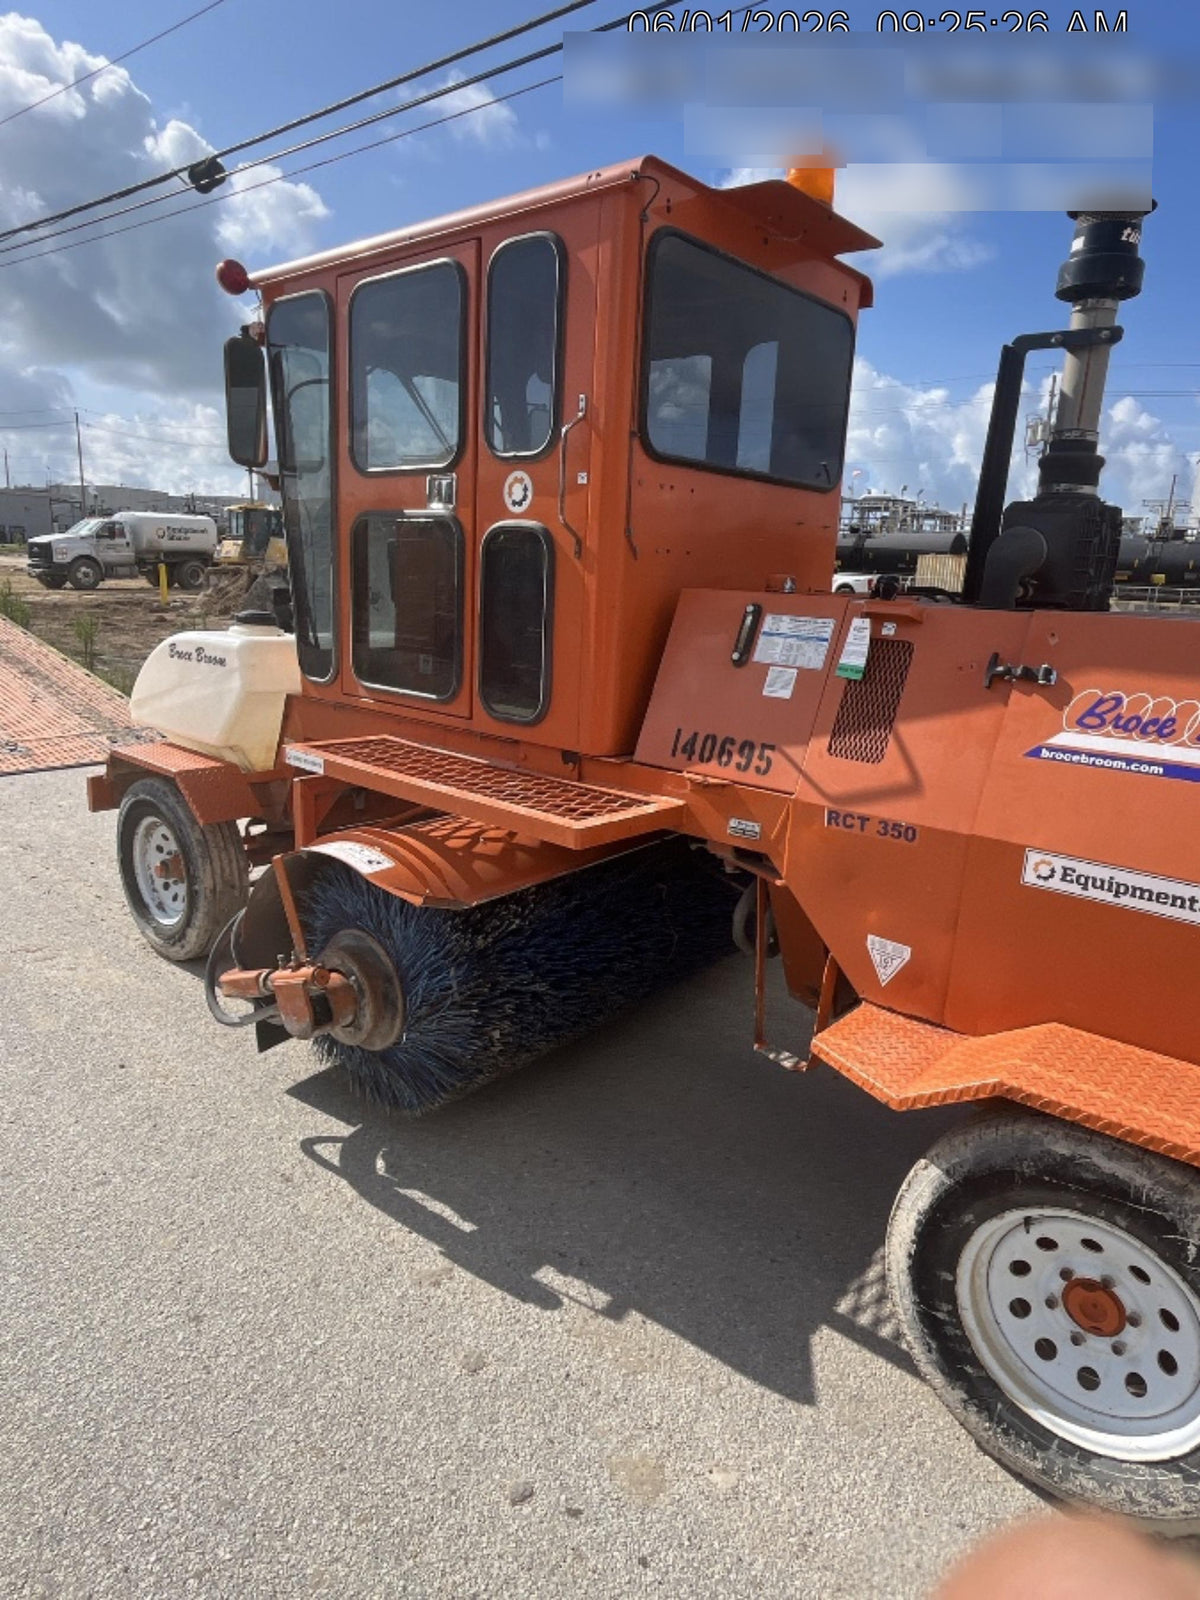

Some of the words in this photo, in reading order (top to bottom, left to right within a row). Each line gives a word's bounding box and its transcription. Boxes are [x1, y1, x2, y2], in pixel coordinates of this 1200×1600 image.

[195, 646, 227, 668] Broom
[1075, 695, 1177, 739] Broce
[671, 728, 776, 776] 140695
[1040, 748, 1164, 774] brocebroom.com
[827, 810, 870, 831] RCT
[876, 820, 917, 843] 350
[1060, 865, 1200, 912] Equipment
